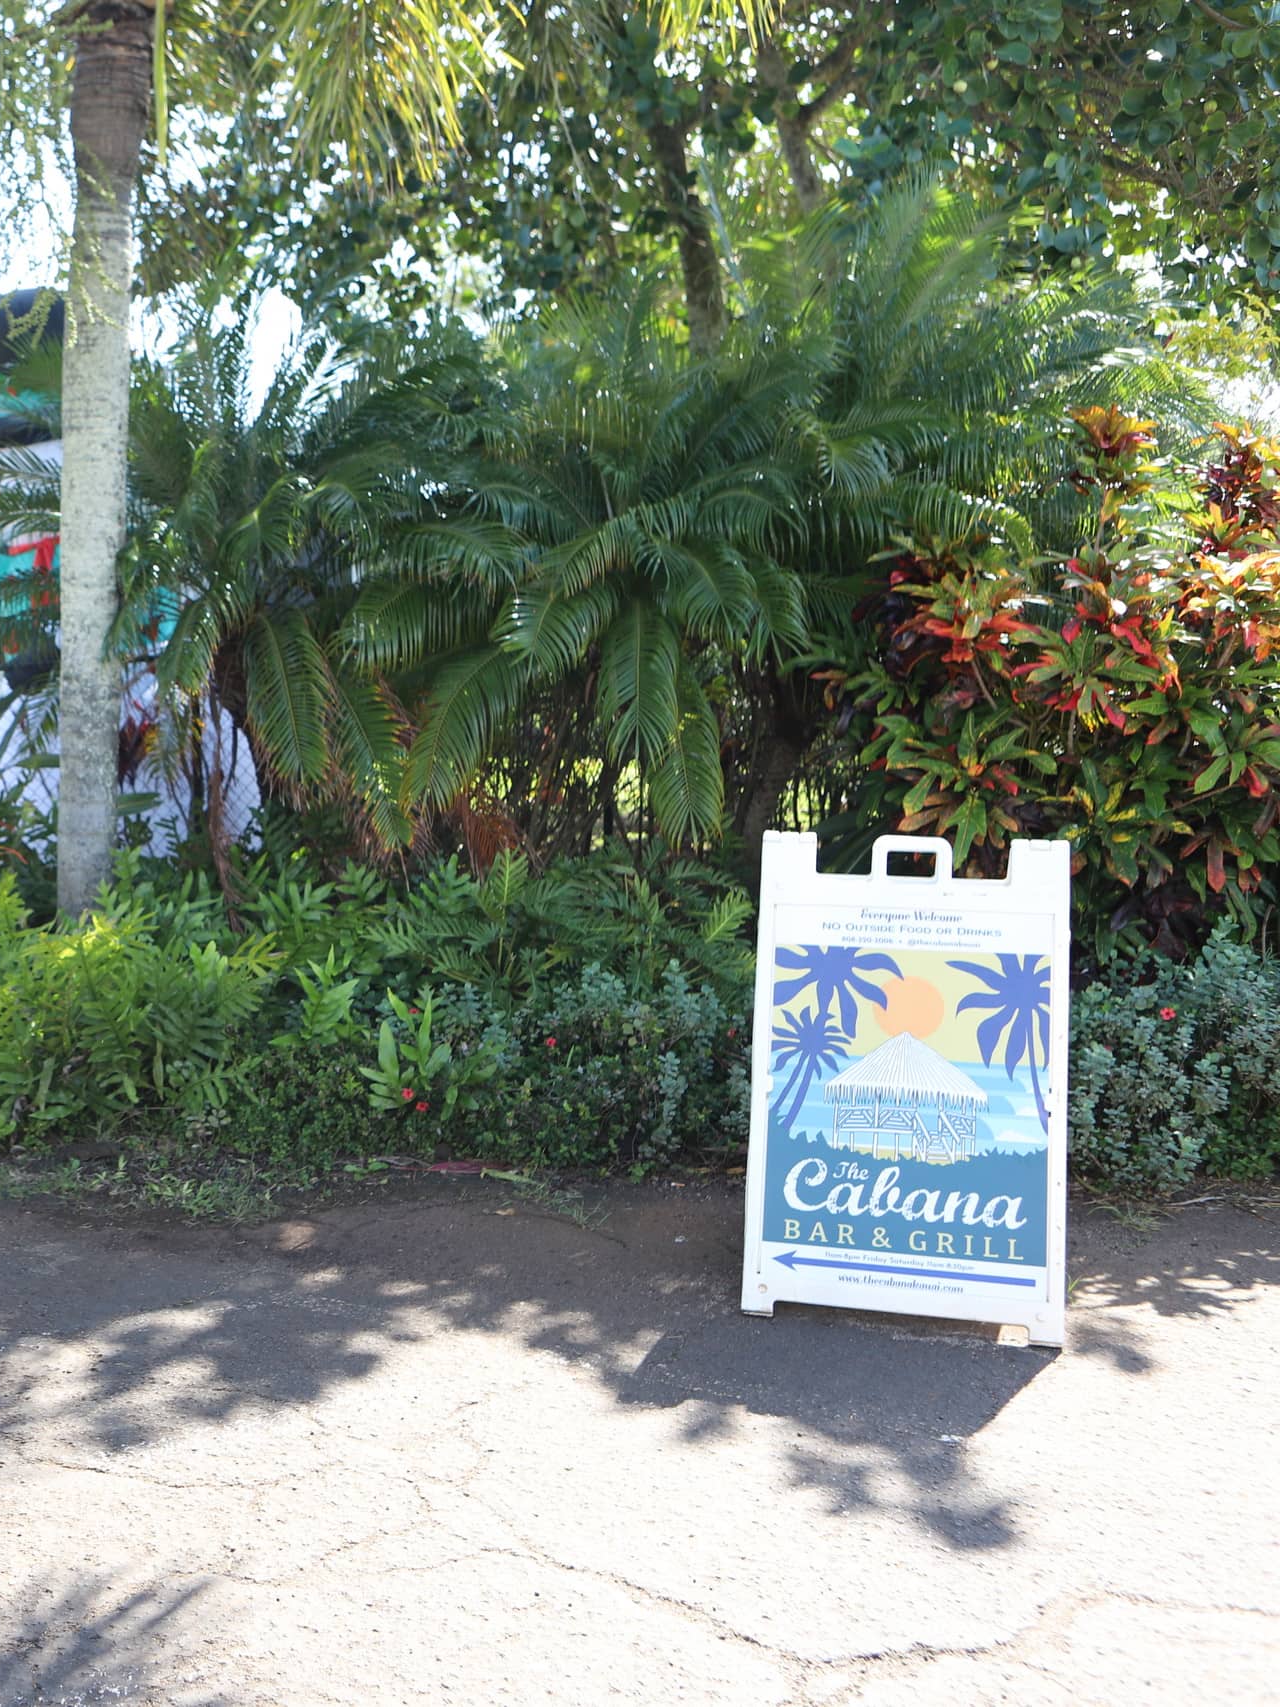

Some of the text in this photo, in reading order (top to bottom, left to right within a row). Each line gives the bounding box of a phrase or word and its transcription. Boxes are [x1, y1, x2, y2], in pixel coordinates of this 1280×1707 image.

[860, 908, 963, 923] Everyone Welcome
[822, 921, 841, 931] NO
[845, 922, 896, 933] OUTSIDE
[899, 925, 932, 935] FOOD
[957, 927, 1003, 938] DRINKS
[833, 1162, 870, 1180] The
[783, 1157, 1028, 1230] Cabana
[783, 1218, 1024, 1260] BAR & GRILL
[838, 1273, 964, 1294] www.thecabanakauai.com
